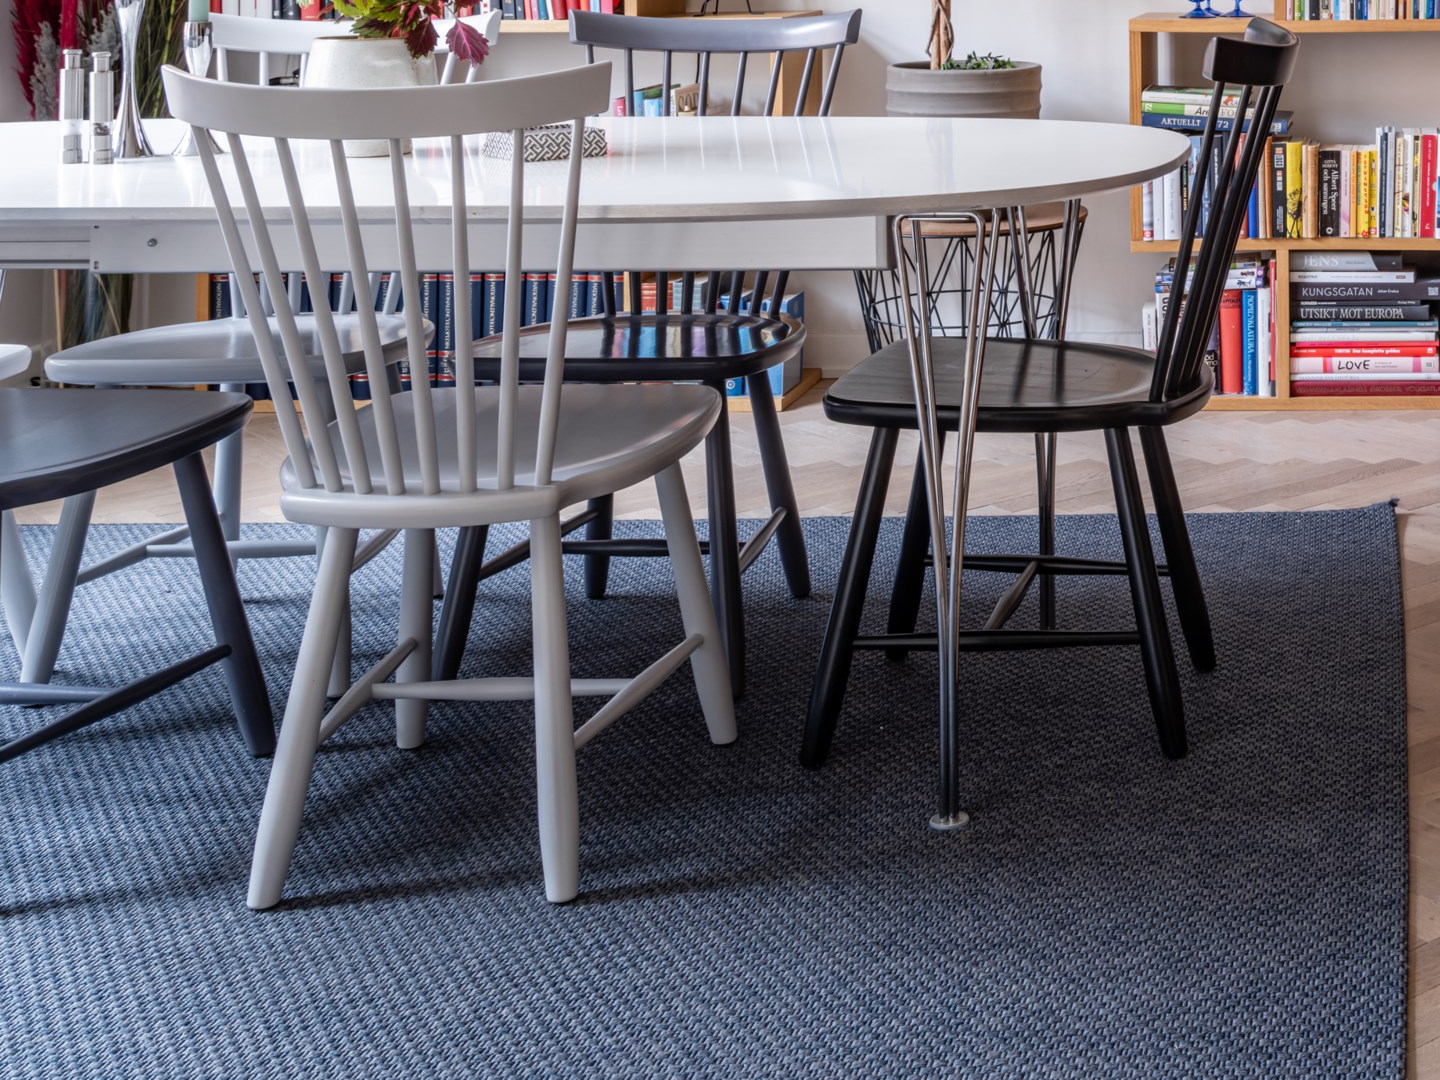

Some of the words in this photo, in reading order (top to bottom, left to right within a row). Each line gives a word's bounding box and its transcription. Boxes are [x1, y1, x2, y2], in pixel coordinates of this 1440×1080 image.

[1160, 117, 1202, 127] AKTUELLT
[1328, 192, 1337, 211] Speer
[1303, 255, 1339, 266] JENS
[1302, 287, 1373, 296] KUNGSGATAN
[1300, 308, 1338, 319] UTSIKT
[1340, 308, 1362, 319] MOT
[1364, 308, 1404, 319] EUROPA
[1338, 360, 1371, 370] LOVE
